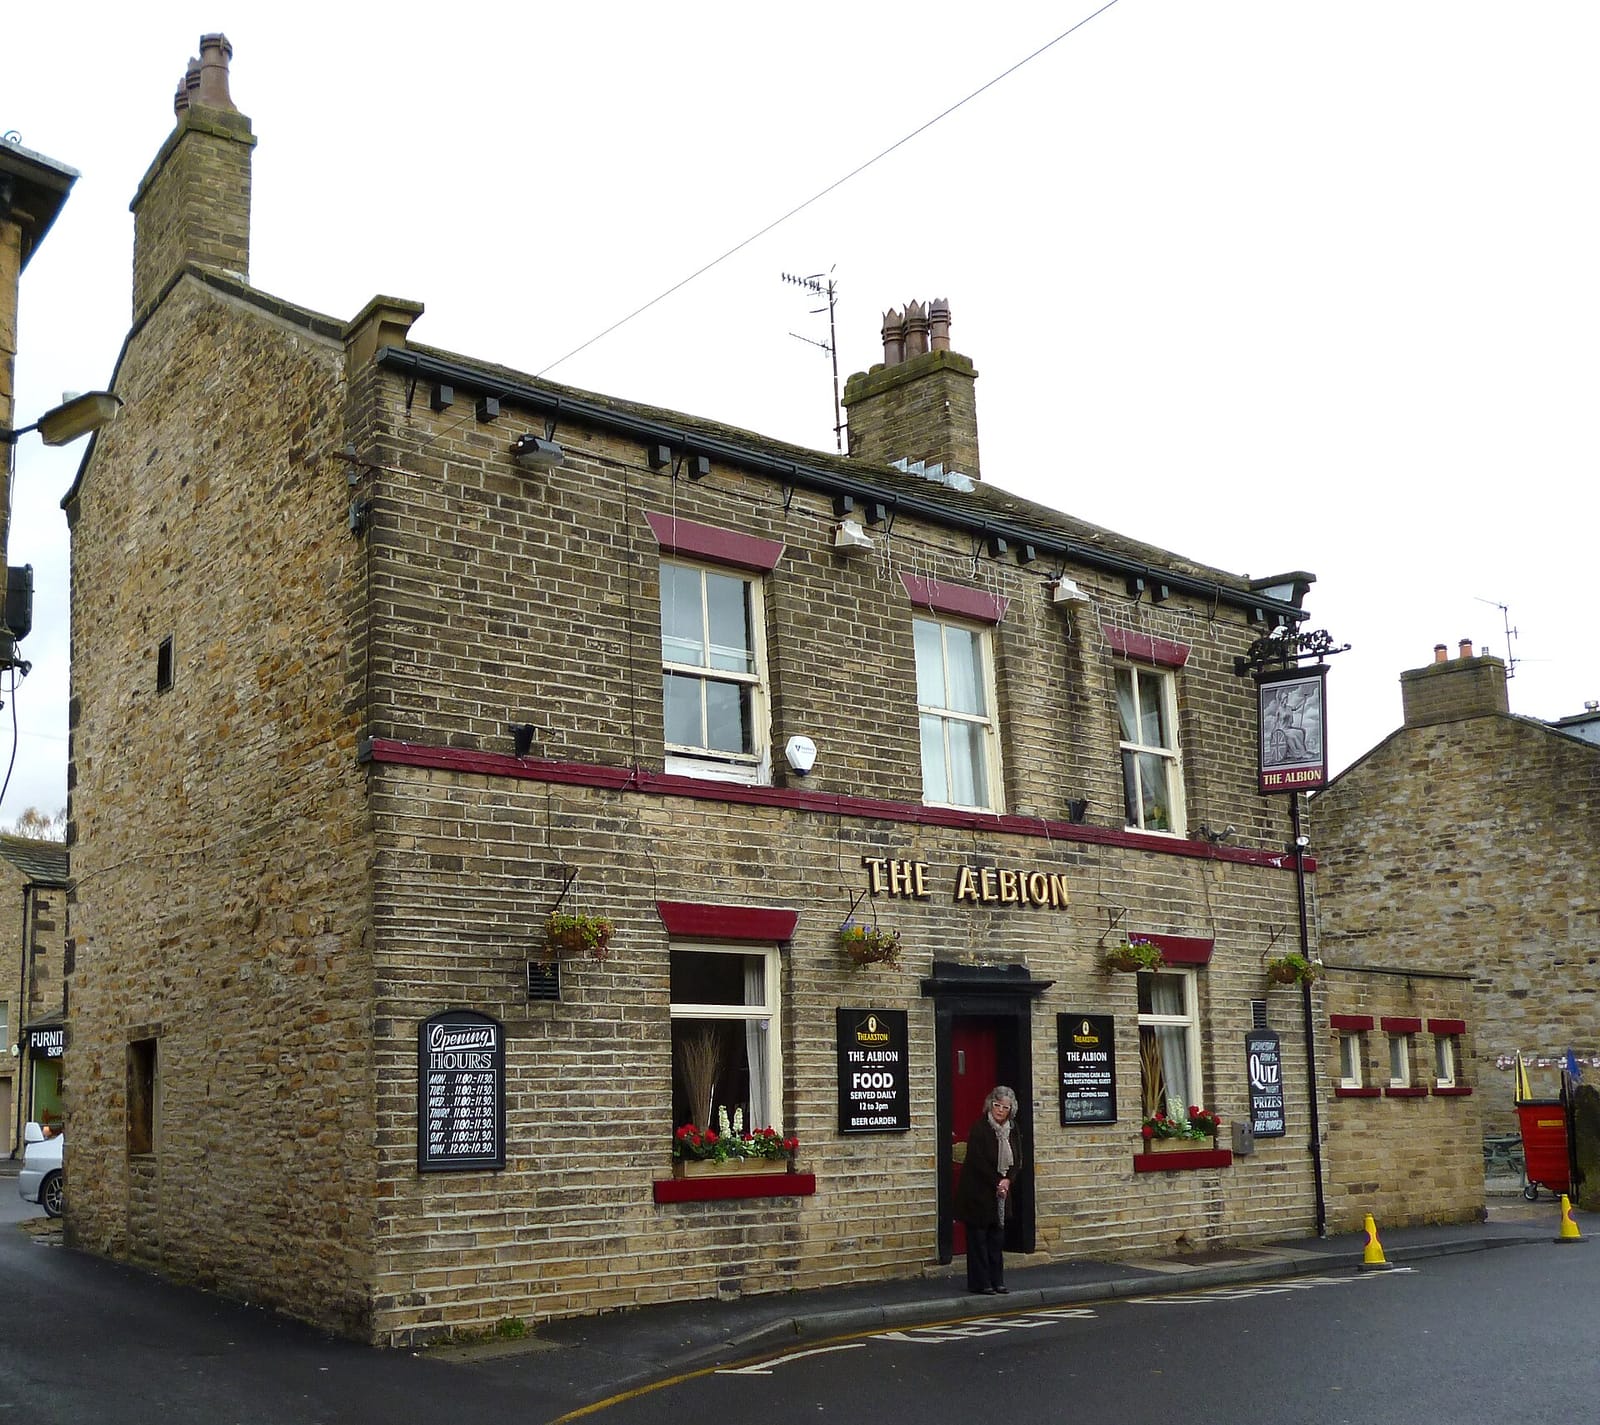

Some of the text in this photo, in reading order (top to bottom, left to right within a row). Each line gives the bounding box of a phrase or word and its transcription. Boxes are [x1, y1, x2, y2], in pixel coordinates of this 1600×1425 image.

[1263, 770, 1321, 785] THE ALBION
[862, 856, 1069, 909] THE ALBION
[431, 1025, 490, 1051] Opening
[857, 1032, 888, 1041] THEAKSTON
[430, 1054, 491, 1069] HOURS
[848, 1051, 898, 1062] THE ALBION
[1066, 1052, 1107, 1061] THE ALBION
[853, 1073, 894, 1088] FOOD
[850, 1091, 896, 1100] SERVED DAILY
[859, 1102, 866, 1110] 12
[875, 1102, 888, 1111] 3pm
[1253, 1096, 1282, 1108] PRIZES
[851, 1116, 896, 1126] BEER GARDEN
